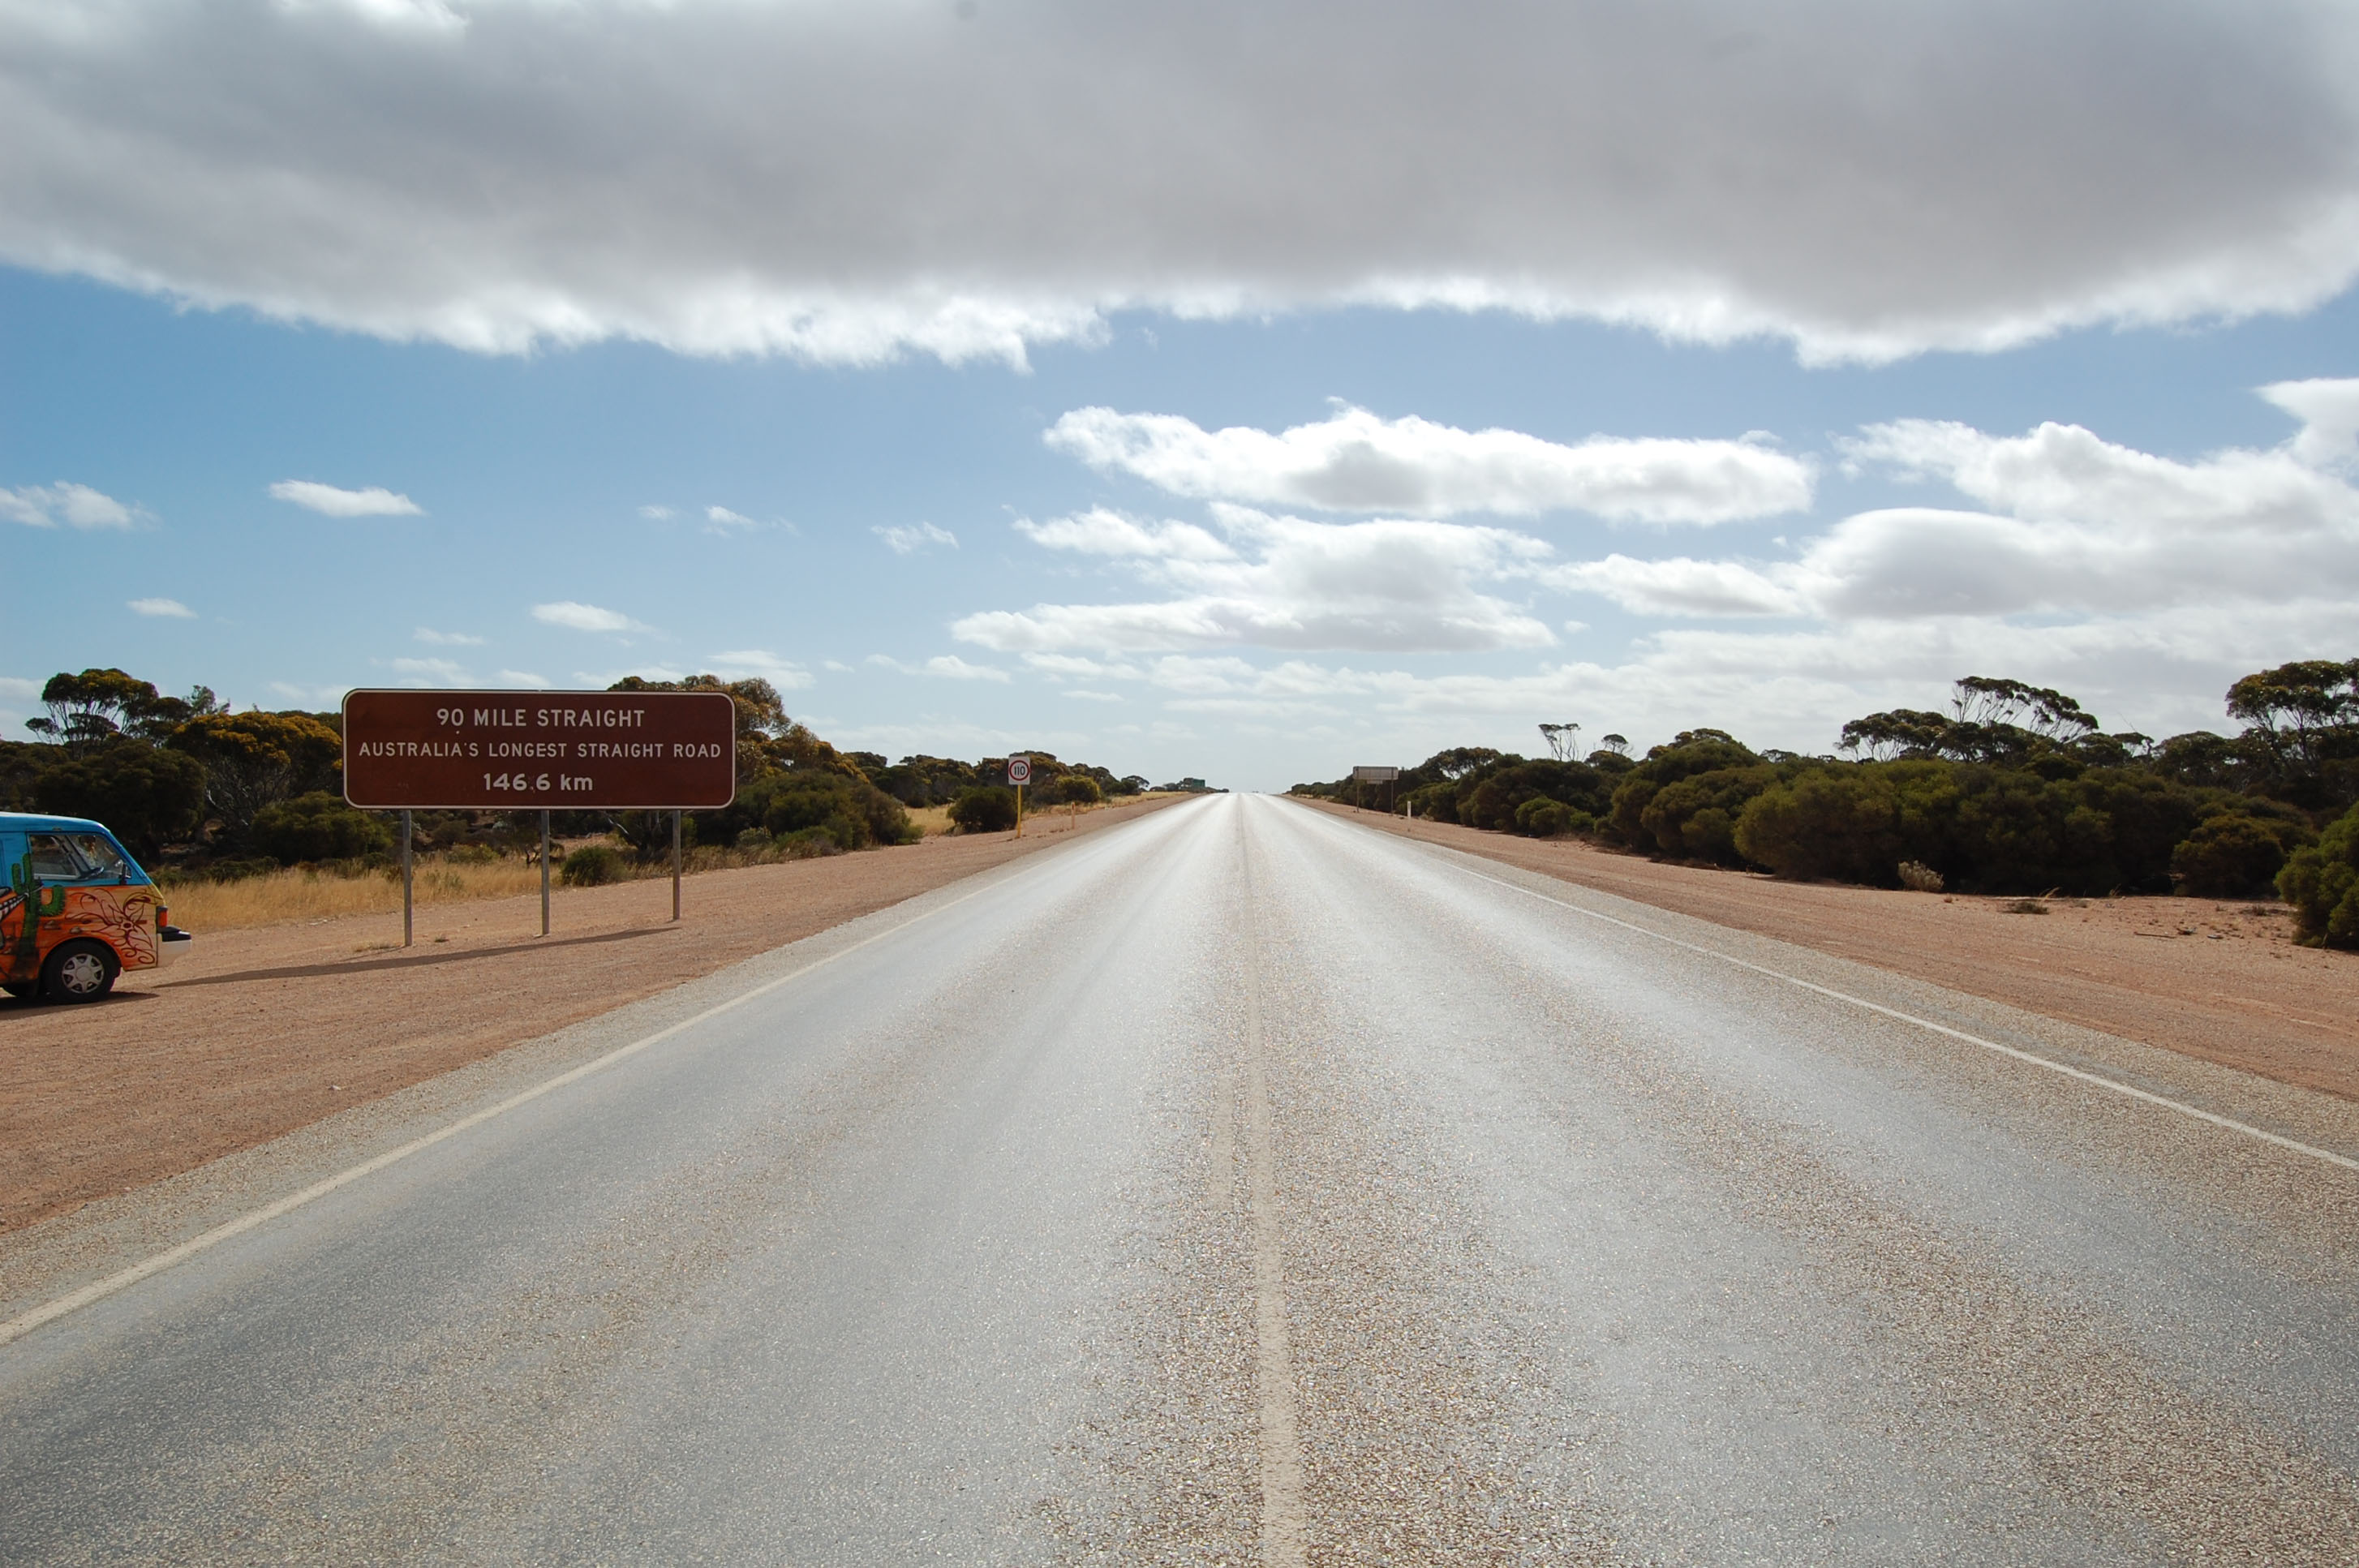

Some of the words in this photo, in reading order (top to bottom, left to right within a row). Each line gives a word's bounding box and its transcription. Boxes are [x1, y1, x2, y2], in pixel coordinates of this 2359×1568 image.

[436, 708, 464, 727] 90
[474, 708, 526, 727] MILE
[537, 708, 645, 728] STRAIGHT
[359, 741, 479, 757] AUSTRALIA'S
[488, 742, 567, 758] LONGEST
[577, 743, 664, 758] STRAIGHT
[673, 743, 721, 758] ROAD
[1014, 766, 1025, 775] 110
[560, 773, 593, 791] km
